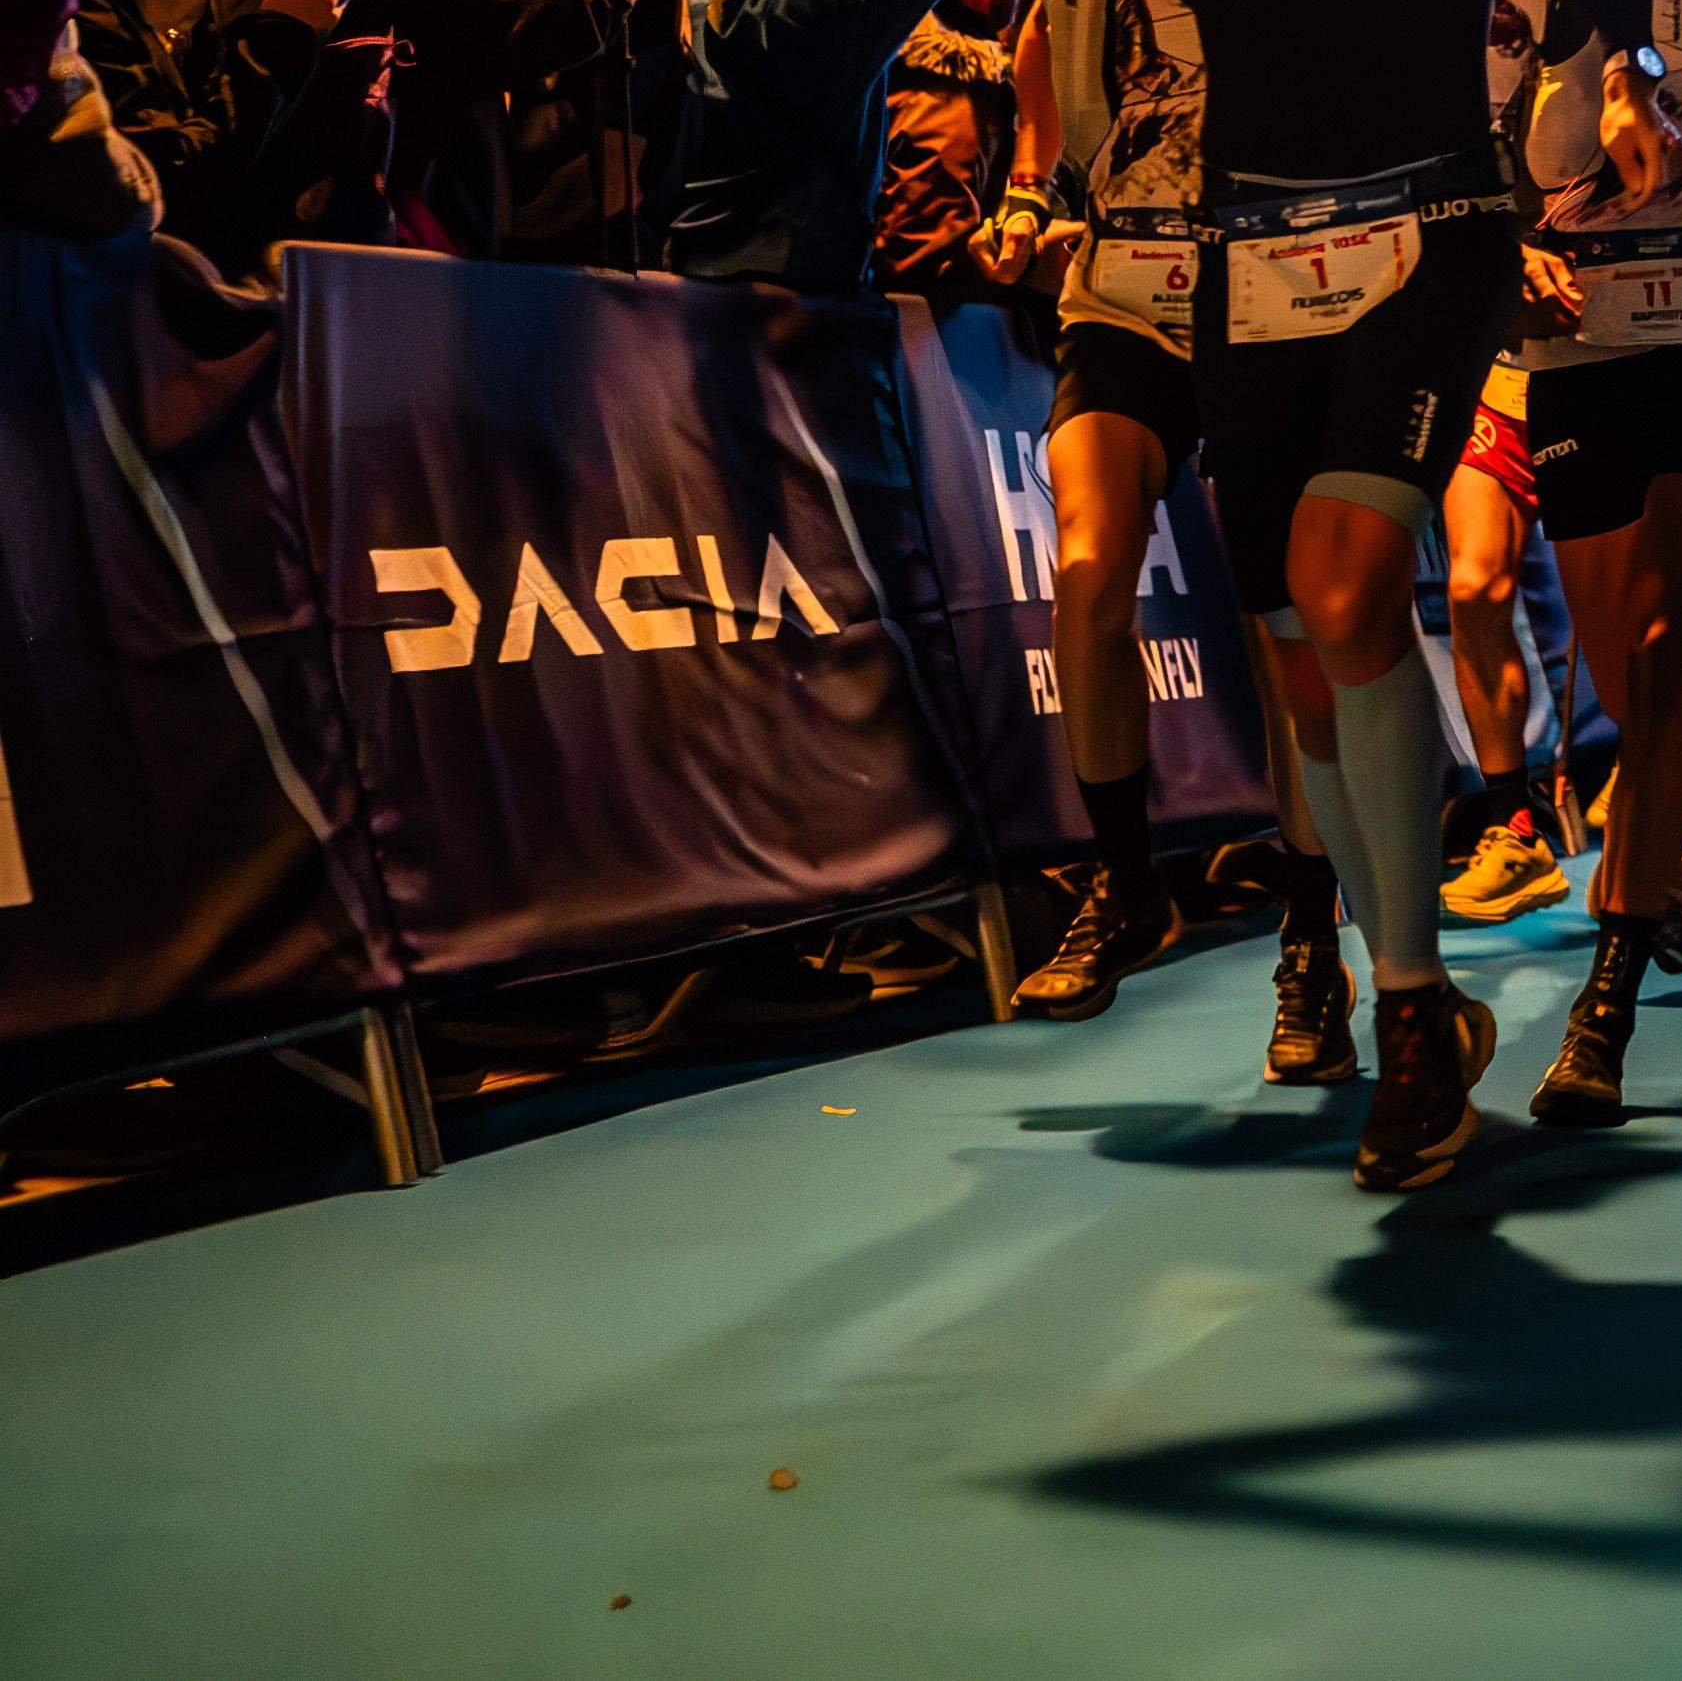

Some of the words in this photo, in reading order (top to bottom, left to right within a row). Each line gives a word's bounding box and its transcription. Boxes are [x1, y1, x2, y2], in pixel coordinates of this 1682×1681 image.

[1166, 264, 1190, 290] 6
[1310, 257, 1329, 289] 1
[1643, 281, 1672, 308] 11
[984, 428, 1190, 602] HA
[369, 532, 840, 674] DACIA
